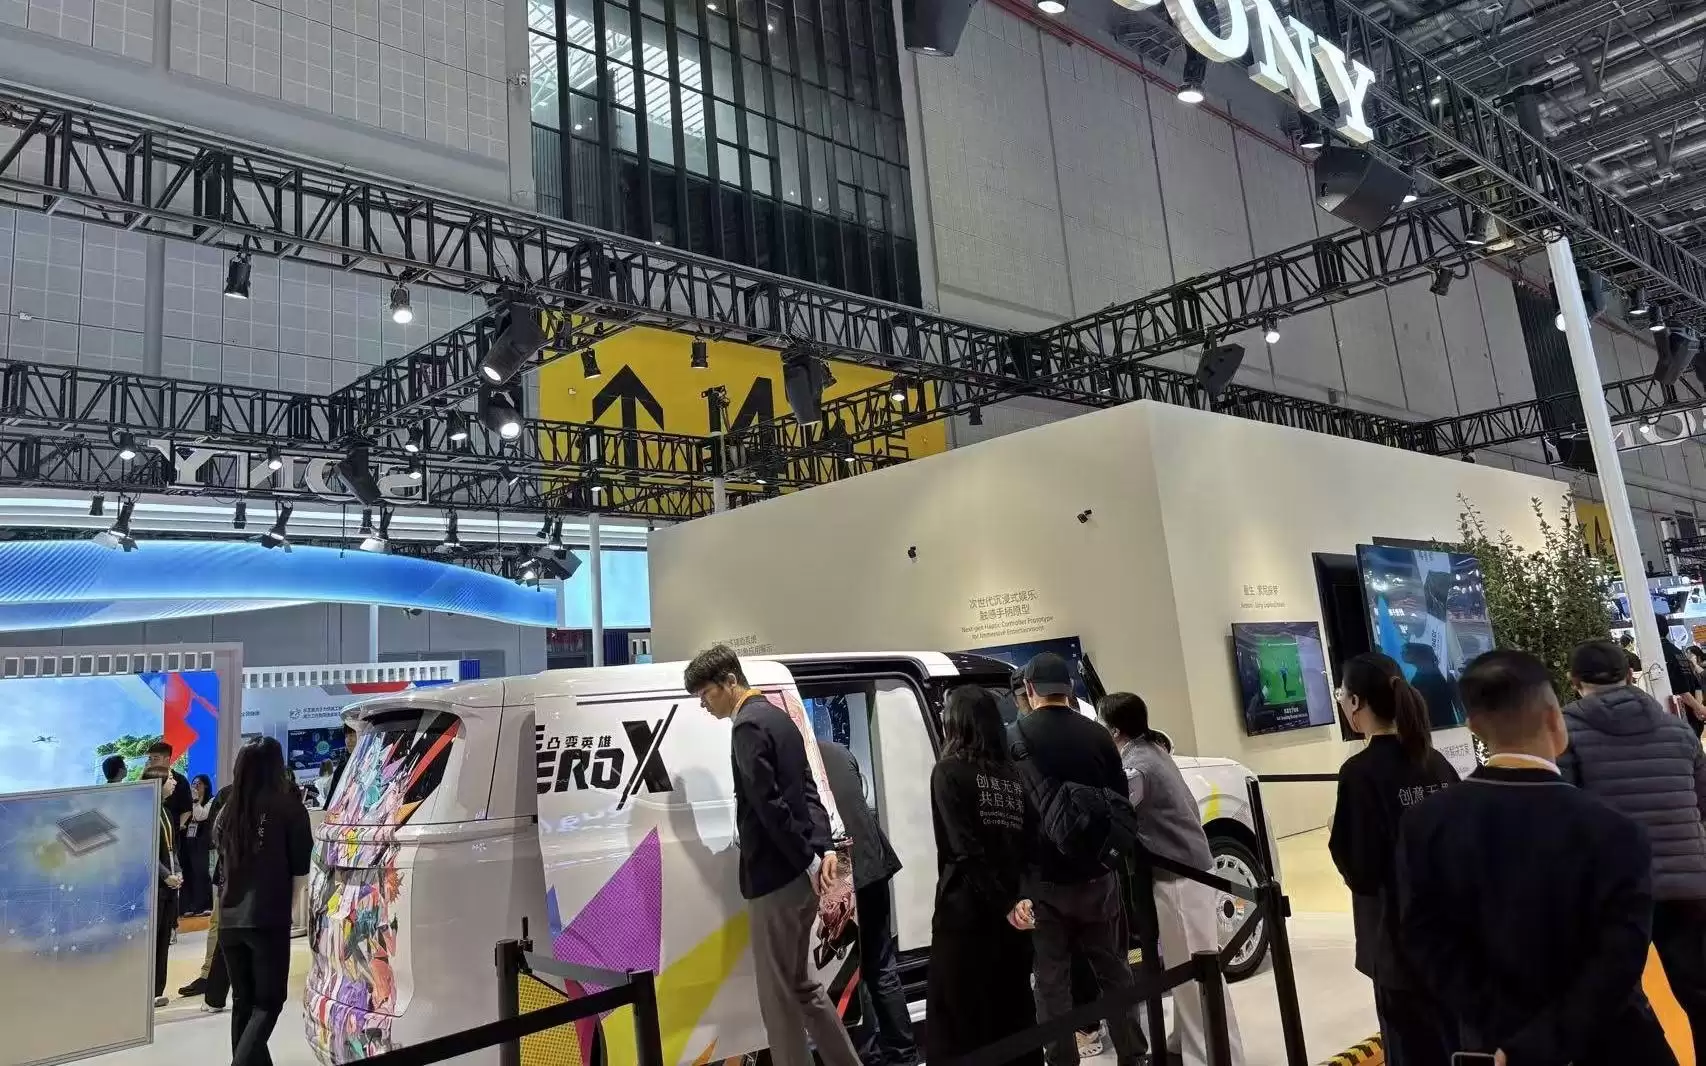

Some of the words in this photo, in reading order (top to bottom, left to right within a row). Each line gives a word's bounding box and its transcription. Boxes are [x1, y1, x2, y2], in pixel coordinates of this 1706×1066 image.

[1110, 0, 1376, 144] ONY
[547, 735, 613, 750] 凸变英雄
